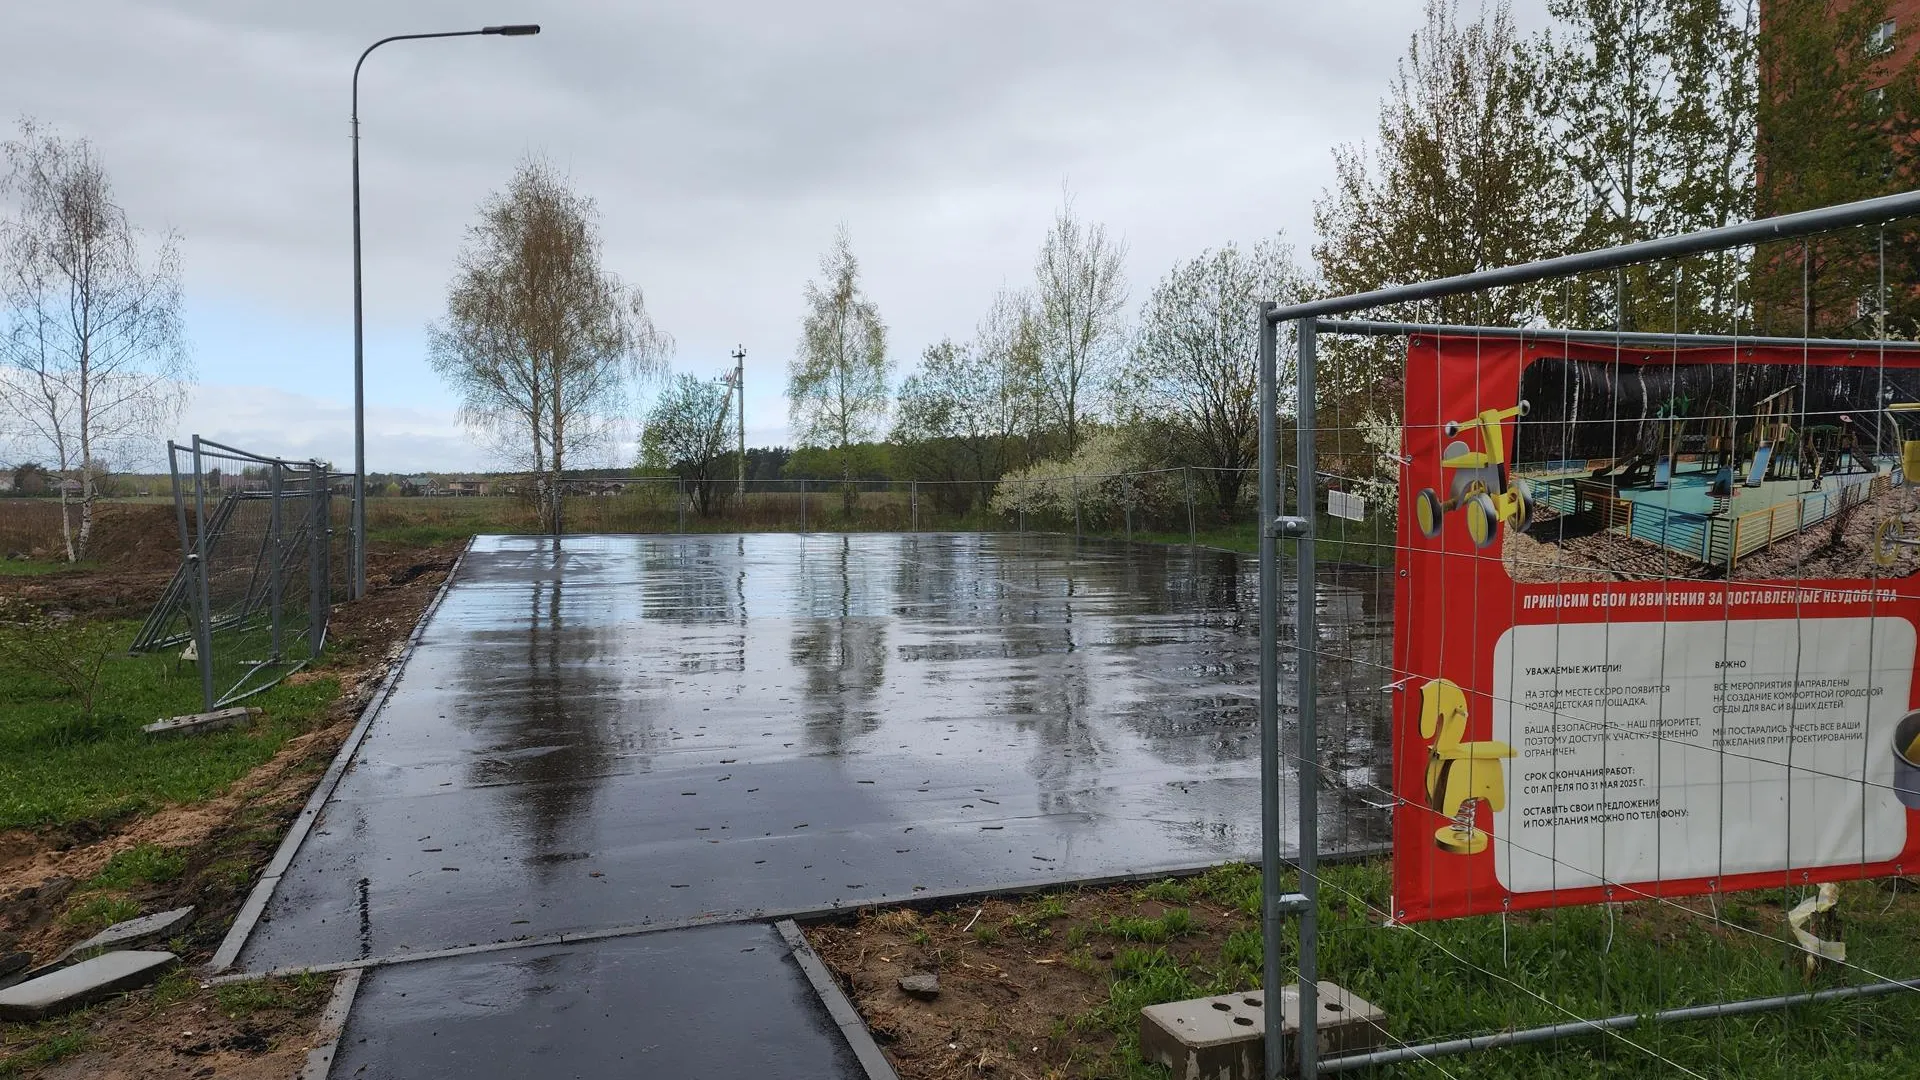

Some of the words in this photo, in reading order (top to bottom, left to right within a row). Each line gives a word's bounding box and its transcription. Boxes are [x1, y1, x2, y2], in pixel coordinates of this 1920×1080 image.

[1523, 593, 1589, 609] ПРИНОСИМ
[1593, 593, 1626, 607] СВОИ
[1630, 592, 1705, 606] ИЗВИНЕНИЯ
[1708, 592, 1722, 605] ЗА
[1726, 590, 1820, 605] ДОСТАВЛЕННЫЕ
[1823, 589, 1897, 604] НЕУДОБСТВА
[1525, 665, 1580, 675] УВАЖАЕМЫЕ
[1582, 665, 1622, 673] ЖИТЕЛИ!
[1715, 661, 1746, 669] ВАЖНО
[1525, 691, 1537, 699] НА
[1539, 689, 1563, 698] ЭТОМ
[1565, 688, 1593, 697] МЕСТЕ
[1594, 686, 1623, 696] СКОРО
[1625, 685, 1670, 694] ПОЯВИТСЯ
[1714, 683, 1728, 691] ВСЕ
[1730, 681, 1792, 690] МЕРОПРИЯТИЯ
[1793, 679, 1850, 688] НАПРАВЛЕНЫ
[1713, 694, 1725, 702] НА
[1727, 692, 1772, 702] СОЗДАНИЕ
[1773, 689, 1833, 700] КОМФОРТНОЙ
[1525, 702, 1554, 711] НОВАЯ
[1556, 700, 1593, 710] ДЕТСКАЯ
[1713, 705, 1741, 714] СРЕДЫ
[1742, 704, 1759, 713] ДЛЯ
[1760, 703, 1776, 712] ВАС
[1778, 702, 1784, 710] И
[1786, 701, 1816, 710] ВАШИХ
[1525, 725, 1549, 734] ВАША
[1627, 720, 1648, 728] НАШ
[1650, 718, 1701, 727] ПРИОРИТЕТ,
[1728, 724, 1787, 735] ПОСТАРАЛИСЬ
[1789, 723, 1819, 732] УЧЕСТЬ
[1820, 722, 1835, 731] ВСЕ
[1836, 721, 1861, 730] ВАШИ
[1525, 736, 1567, 746] ПОЭТОМУ
[1569, 734, 1603, 744] ДОСТУП
[1605, 733, 1611, 741] К
[1652, 729, 1698, 739] ВРЕМЕННО
[1712, 736, 1765, 747] ПОЖЕЛАНИЯ
[1767, 736, 1784, 744] ПРИ
[1524, 772, 1547, 781] СРОК
[1606, 767, 1635, 776] РАБОТ:
[1531, 786, 1539, 794] 01
[1540, 784, 1573, 793] АПРЕЛЯ
[1575, 782, 1589, 791] ПО
[1590, 782, 1598, 790] 31
[1600, 780, 1618, 789] МАЯ
[1619, 779, 1637, 788] 2025
[1639, 779, 1645, 787] Г.
[1523, 805, 1568, 816] ОСТАВИТЬ
[1570, 804, 1594, 813] СВОИ
[1596, 799, 1660, 811] ПРЕДЛОЖЕНИЯ
[1523, 820, 1530, 828] И
[1531, 816, 1588, 827] ПОЖЕЛАНИЯ
[1590, 813, 1624, 824] МОЖНО
[1626, 812, 1639, 821] ПО
